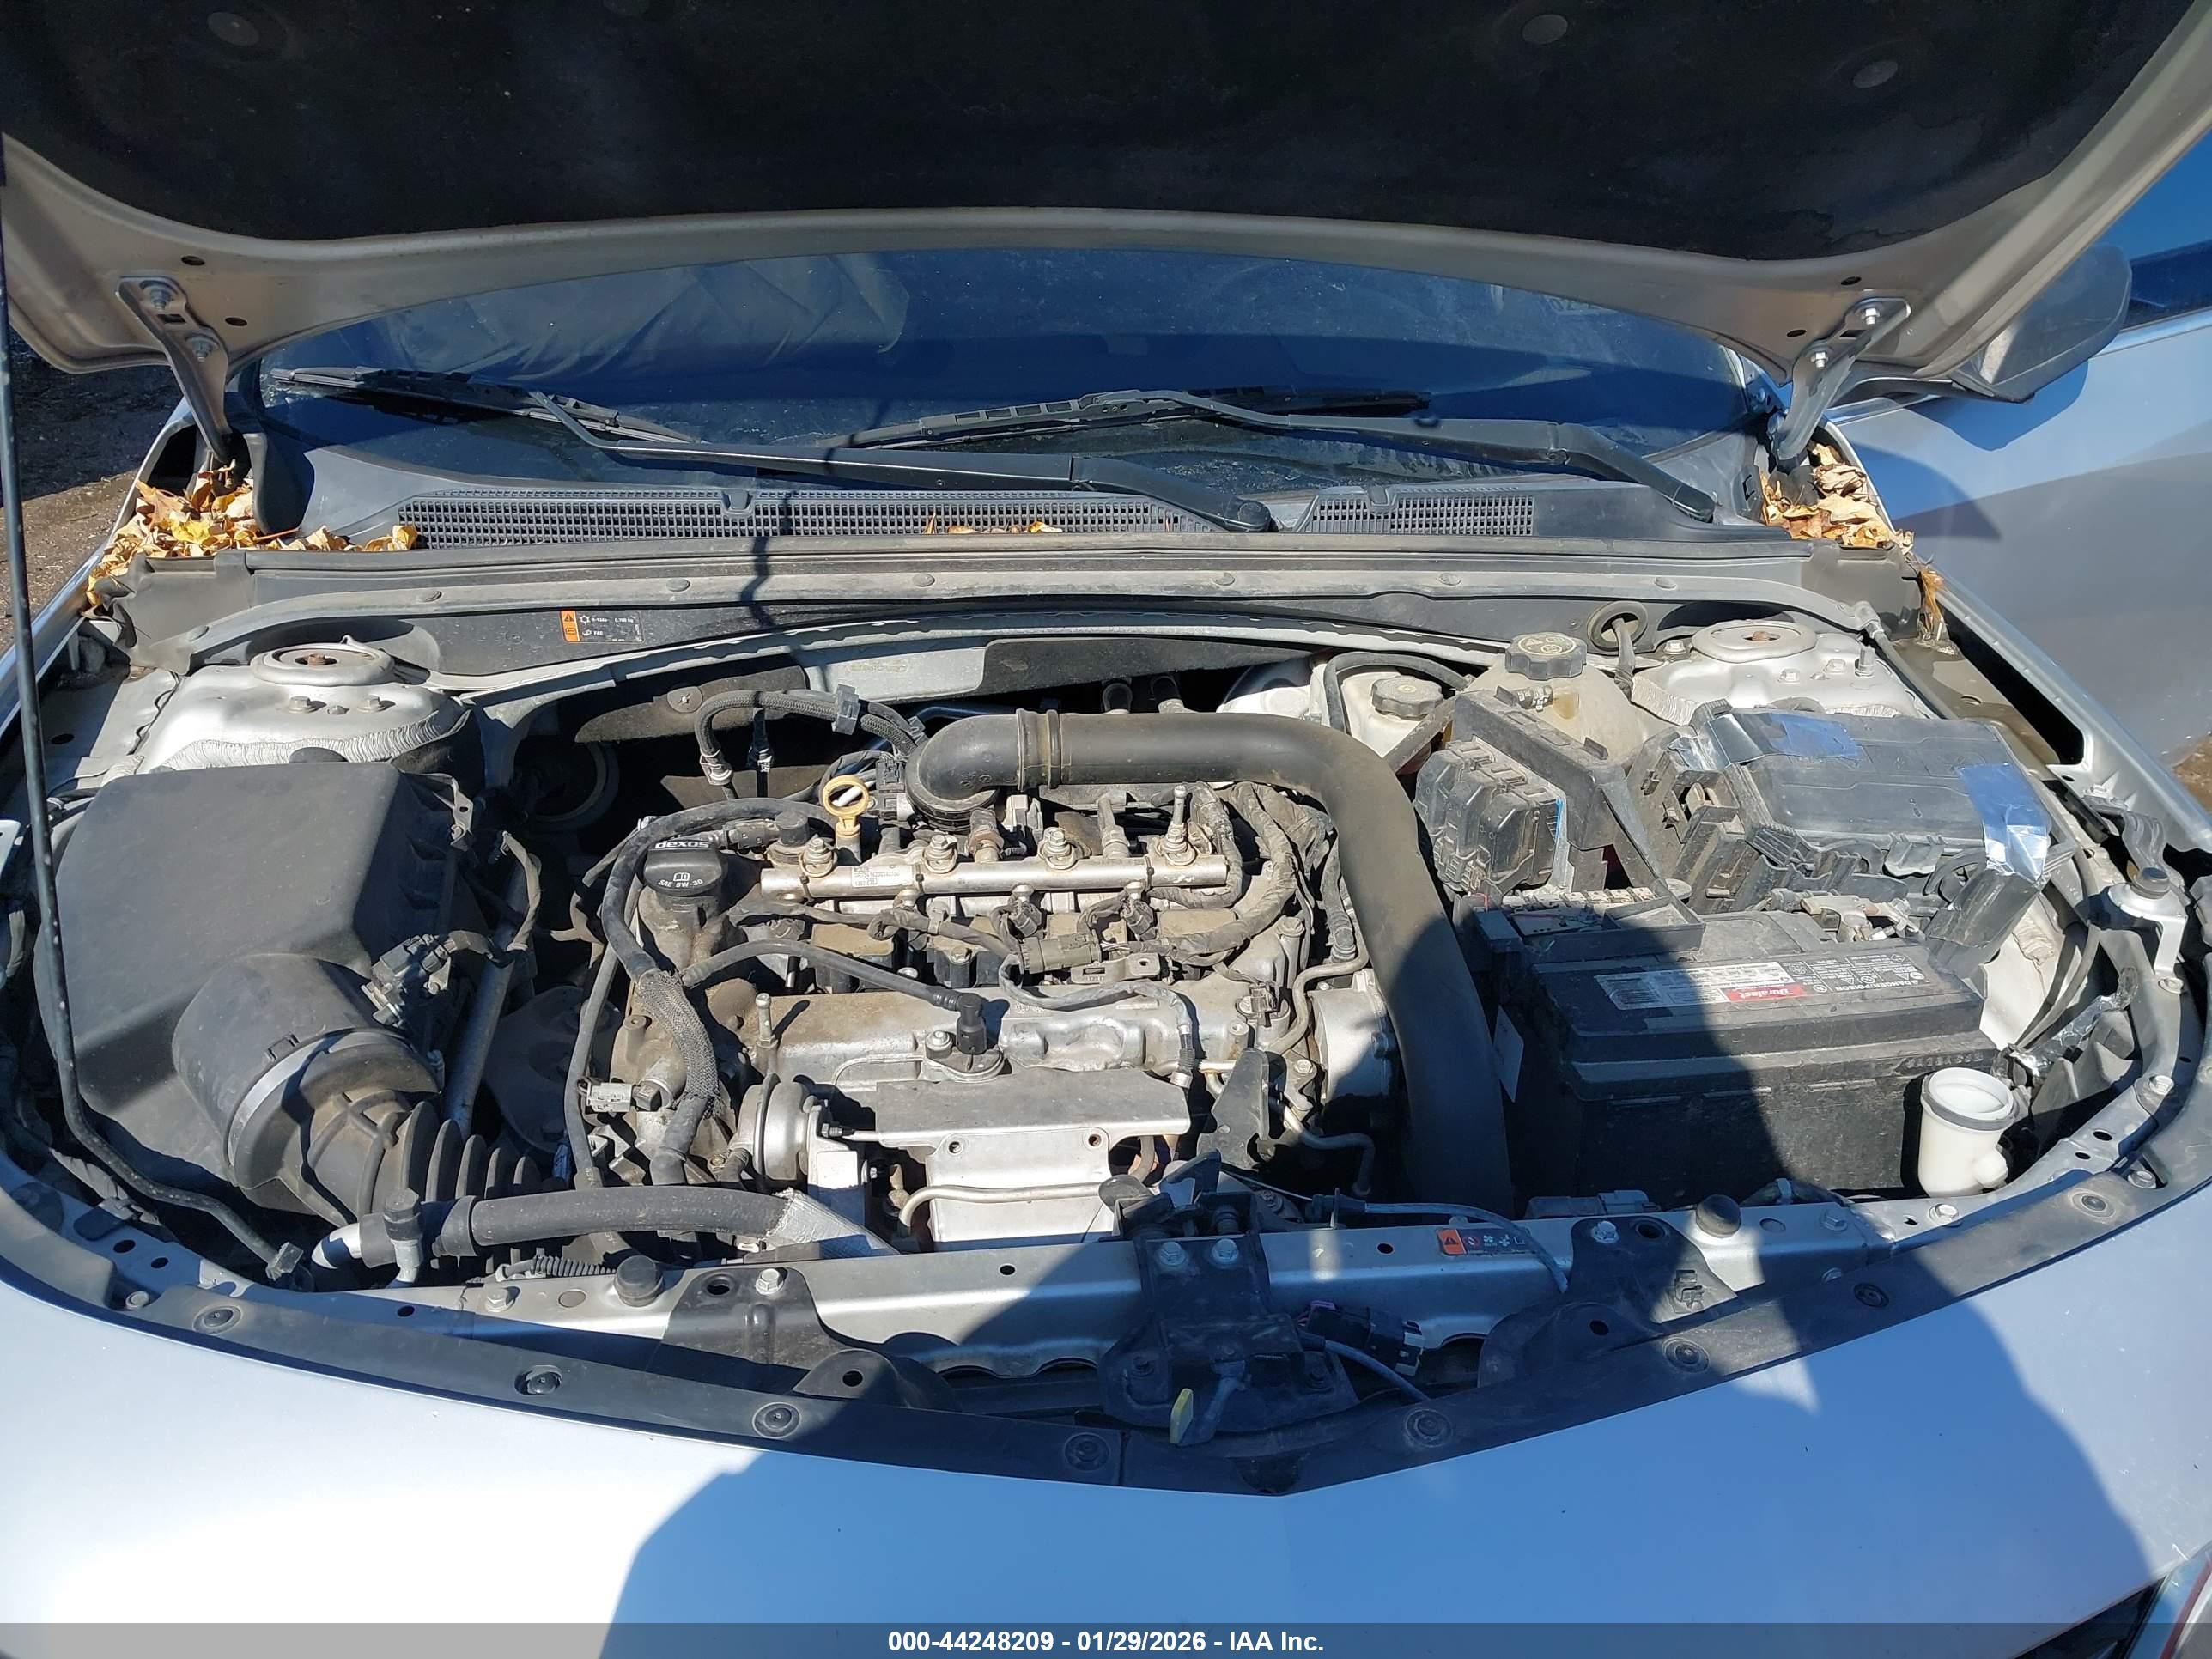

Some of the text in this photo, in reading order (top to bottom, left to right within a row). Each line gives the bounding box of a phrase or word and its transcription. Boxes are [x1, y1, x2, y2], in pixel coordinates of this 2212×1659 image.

[658, 878, 704, 888] SAE 5W-30
[1834, 980, 1911, 992] DANGER/POISON
[1737, 988, 1794, 999] Duralast
